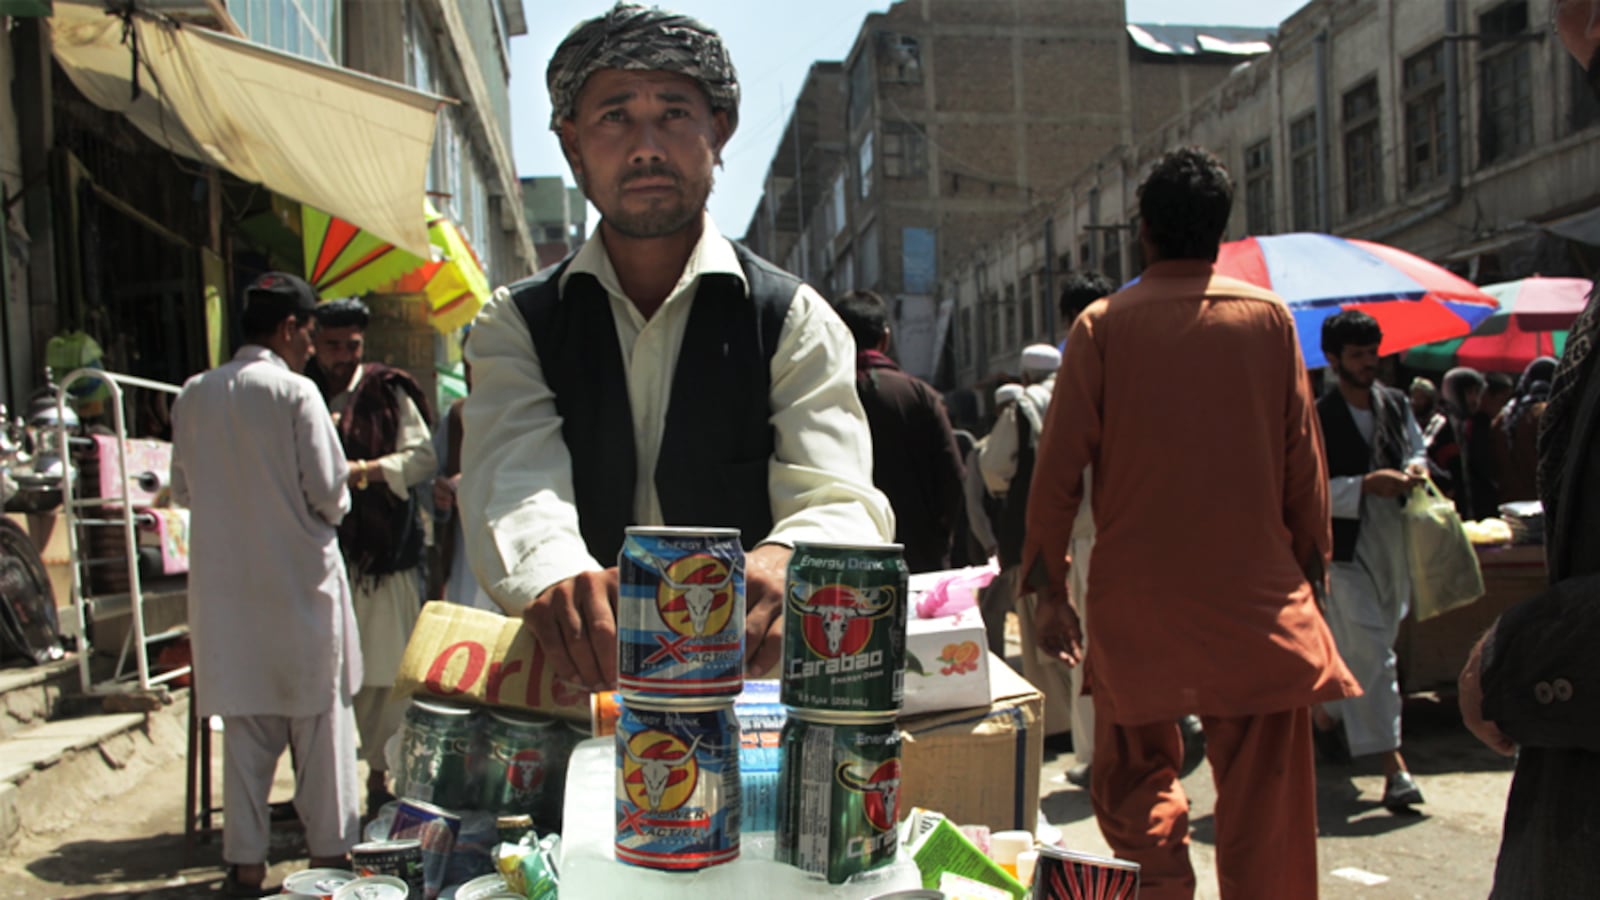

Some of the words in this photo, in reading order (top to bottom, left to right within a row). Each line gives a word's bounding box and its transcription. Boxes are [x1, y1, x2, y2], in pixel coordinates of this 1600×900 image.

[801, 554, 844, 570] Energy
[848, 557, 885, 571] Drink
[790, 649, 883, 680] Carabao
[646, 809, 705, 820] POWER
